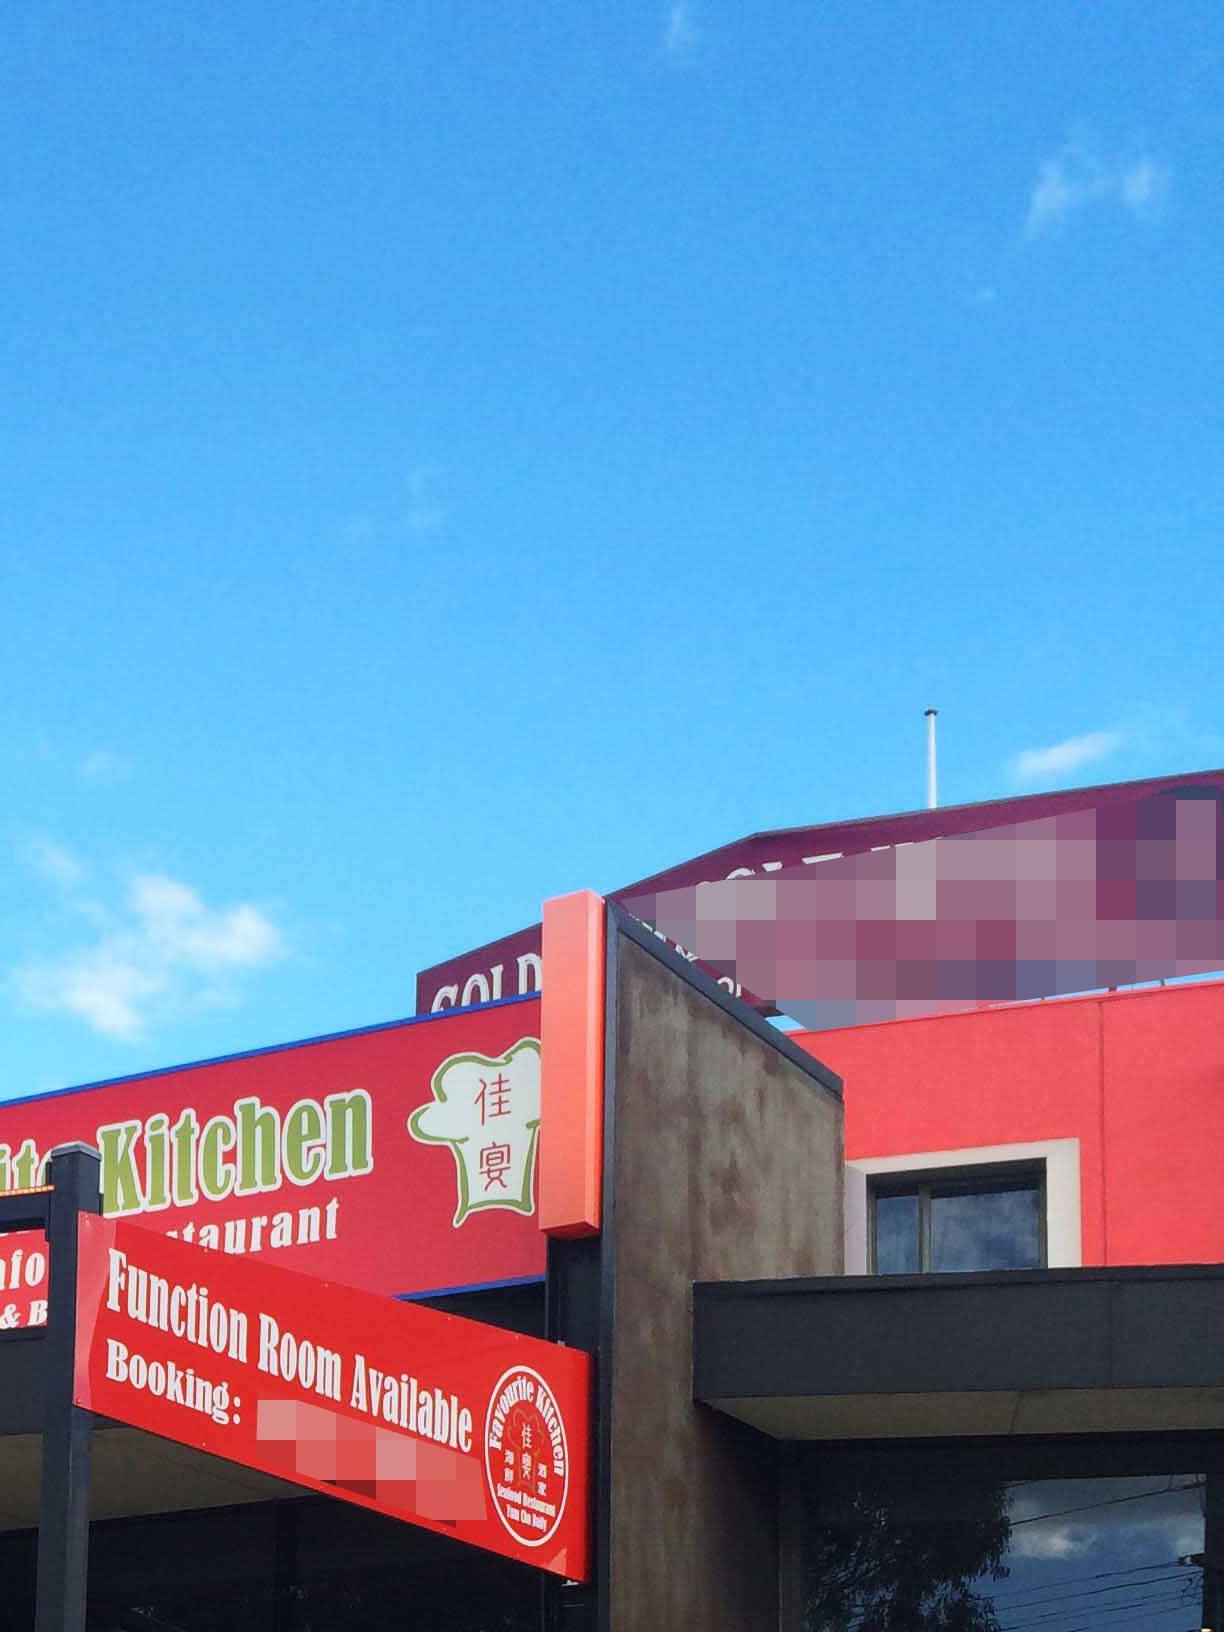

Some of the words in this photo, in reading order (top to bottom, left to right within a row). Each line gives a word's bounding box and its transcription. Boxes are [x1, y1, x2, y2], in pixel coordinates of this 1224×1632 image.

[97, 1089, 373, 1218] Kitchen
[474, 1073, 512, 1192] 佳宴
[164, 1197, 339, 1256] taurant
[106, 1247, 248, 1364] Function
[257, 1312, 342, 1402] Room
[350, 1354, 474, 1454] Available
[106, 1338, 241, 1426] Booking:
[489, 1375, 535, 1450] Favourite
[535, 1385, 565, 1477] Kitchen
